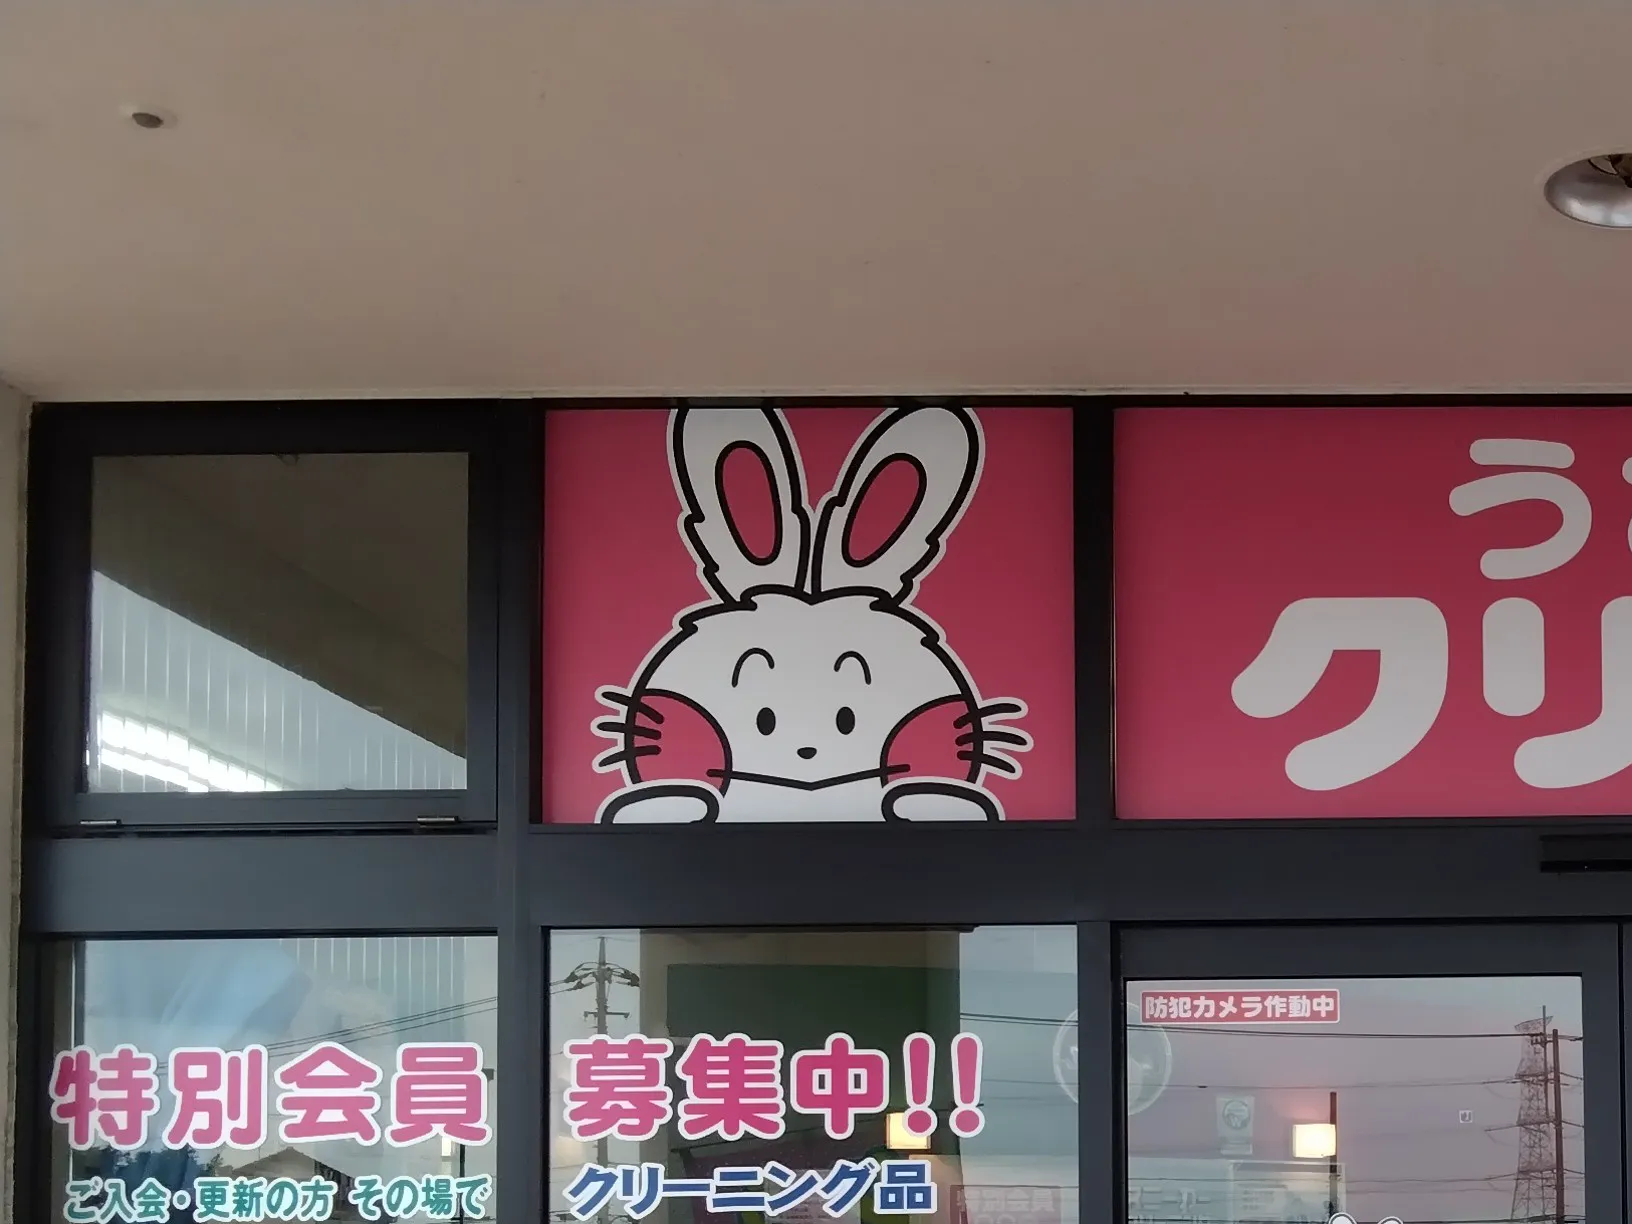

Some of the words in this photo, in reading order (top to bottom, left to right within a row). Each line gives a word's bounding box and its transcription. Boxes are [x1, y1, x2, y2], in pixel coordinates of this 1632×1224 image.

[1146, 995, 1335, 1020] 防犯カメラ作動中
[50, 1043, 492, 1151] 特別会員
[564, 1031, 984, 1141] 募集中!!
[348, 1174, 492, 1221] その場で
[567, 1159, 936, 1220] クリーニング品
